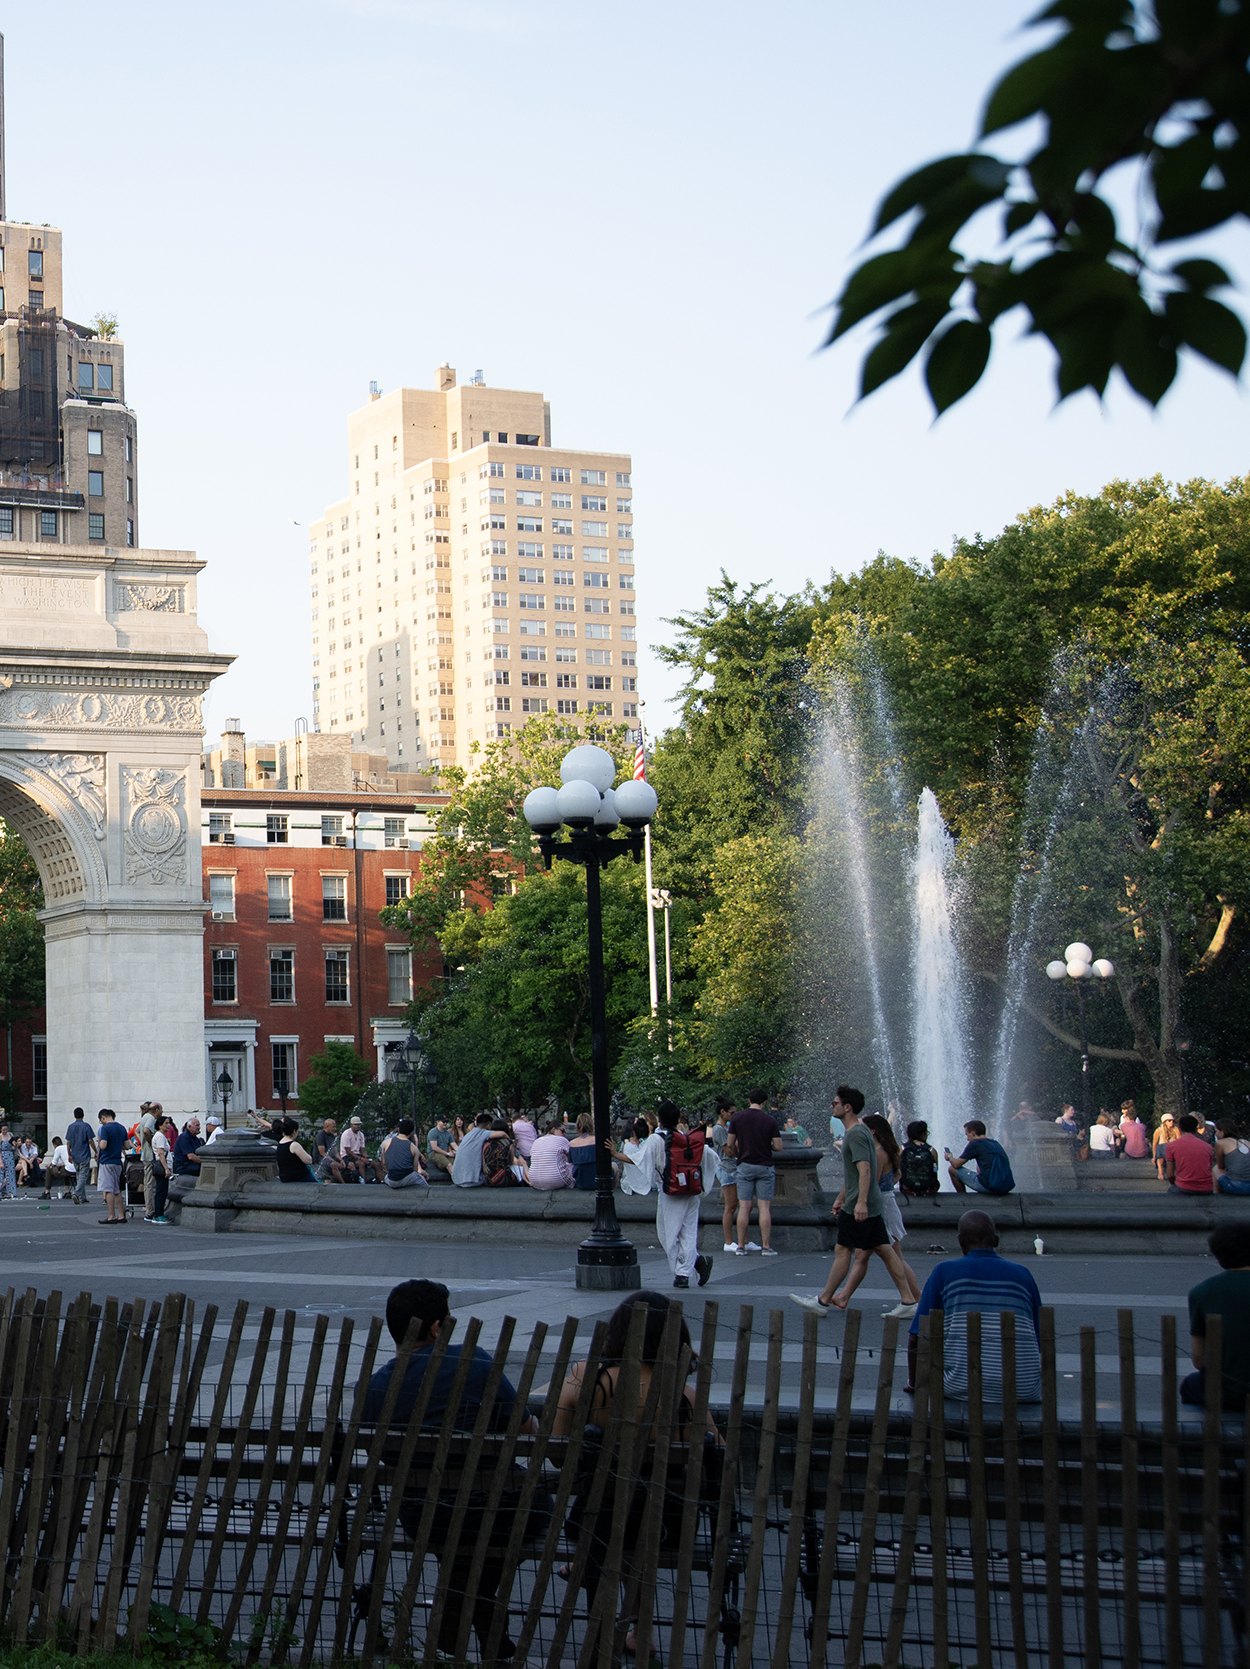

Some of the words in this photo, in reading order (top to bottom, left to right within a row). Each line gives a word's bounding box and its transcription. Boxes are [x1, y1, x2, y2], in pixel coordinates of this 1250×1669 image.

[38, 578, 59, 588] THE
[62, 580, 88, 589] WISE
[23, 587, 45, 597] THE
[51, 589, 88, 599] EVENT
[14, 597, 90, 609] WASHINGTON
